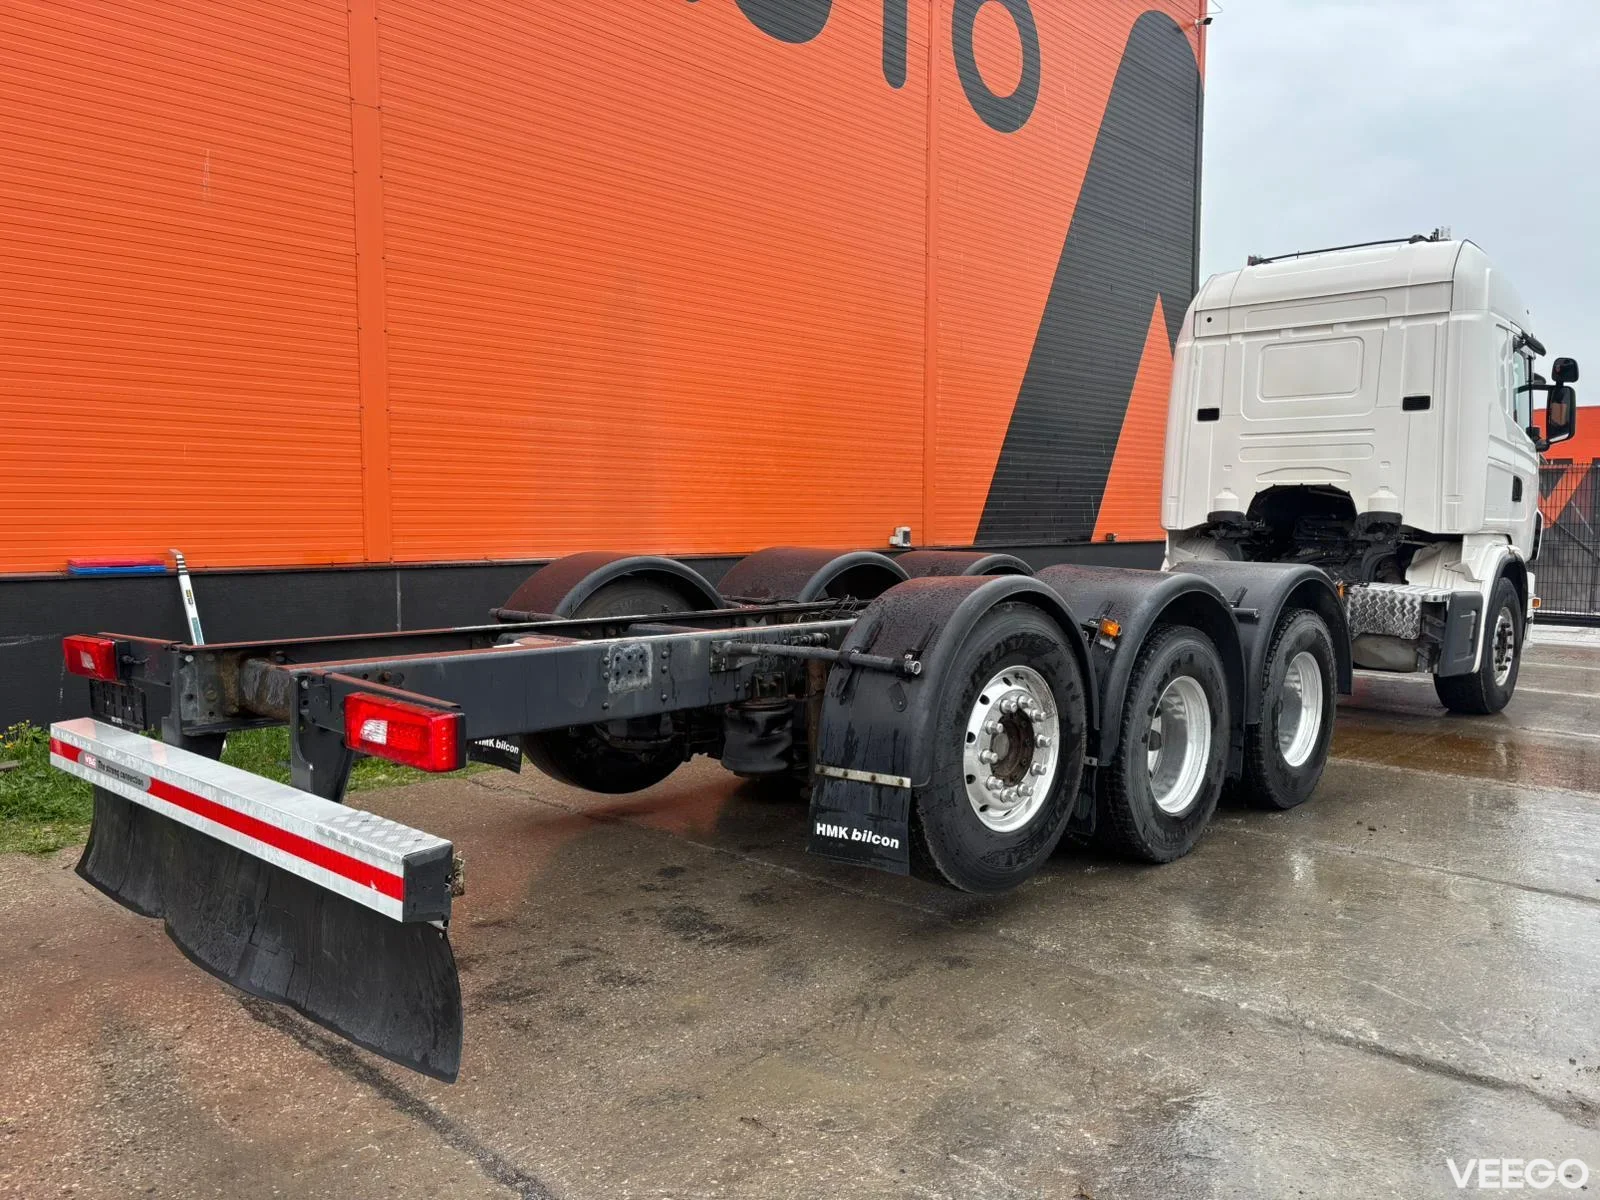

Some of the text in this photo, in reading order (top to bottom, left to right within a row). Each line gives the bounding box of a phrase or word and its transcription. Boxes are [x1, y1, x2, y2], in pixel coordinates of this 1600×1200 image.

[474, 738, 519, 754] MK bilcon
[98, 760, 144, 787] The strong connection
[816, 822, 900, 849] HMK bilcon
